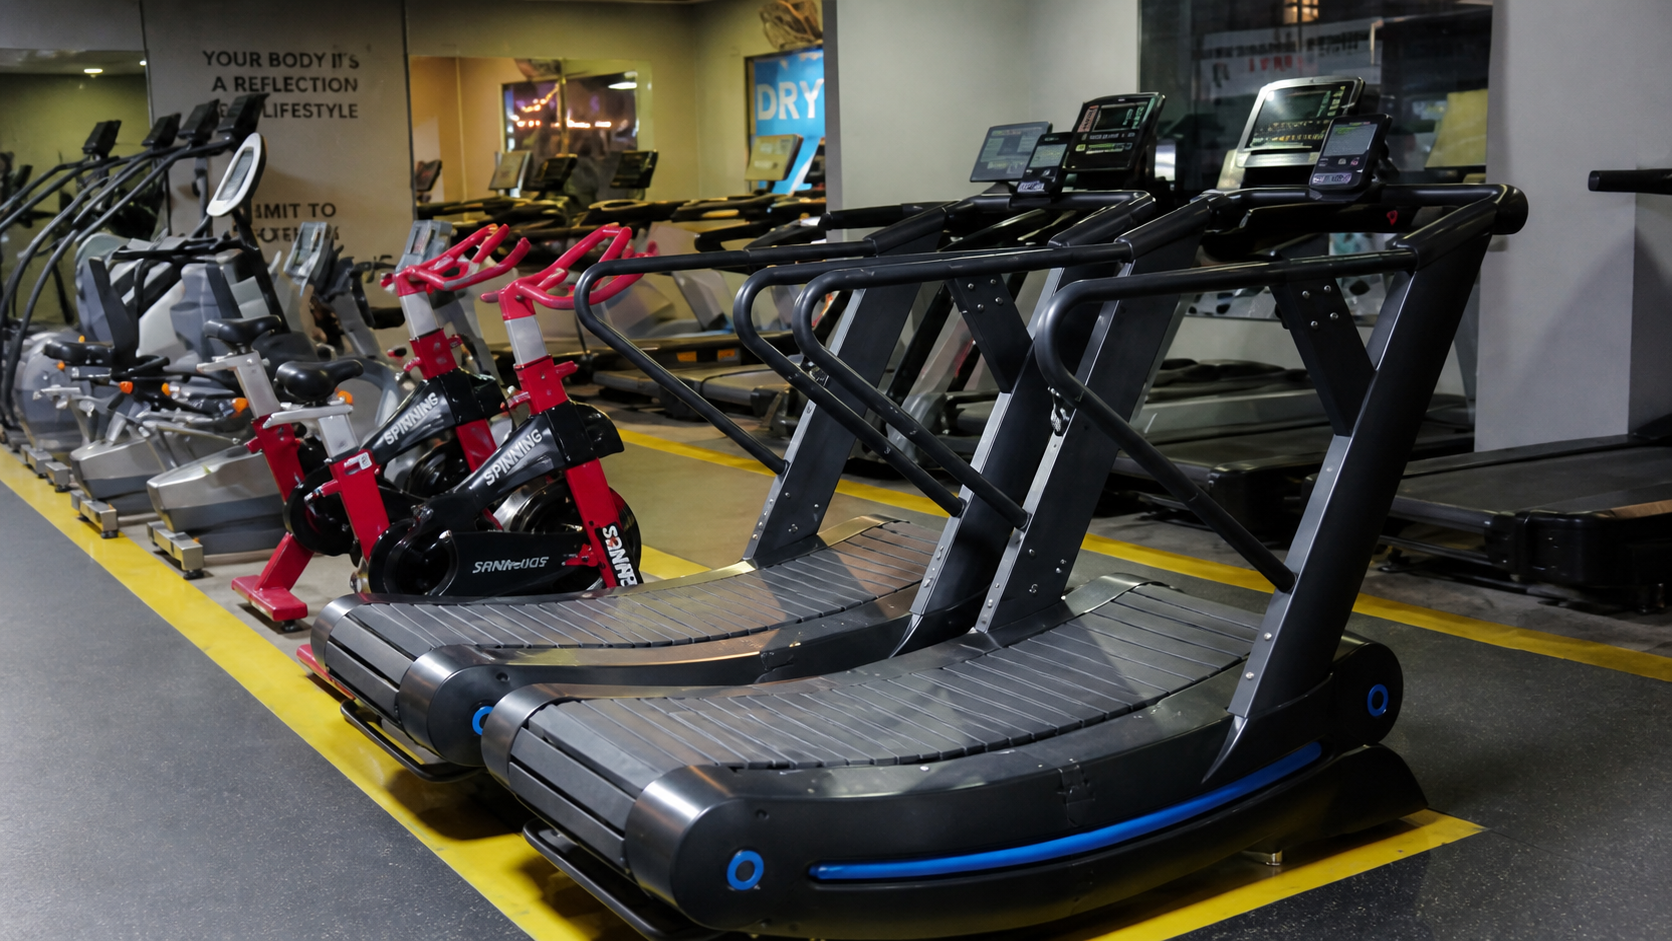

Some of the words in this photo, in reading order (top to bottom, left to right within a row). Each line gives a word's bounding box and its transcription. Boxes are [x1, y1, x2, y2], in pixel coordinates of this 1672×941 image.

[202, 51, 262, 67] YOUR
[268, 52, 326, 68] BODY
[212, 76, 227, 92] A
[234, 76, 358, 93] REFLECTION
[757, 78, 825, 121] DRY
[262, 103, 358, 118] LIFESTYLE
[308, 203, 336, 218] TO
[384, 392, 439, 445] SPINNING
[483, 429, 543, 486] SPINNING
